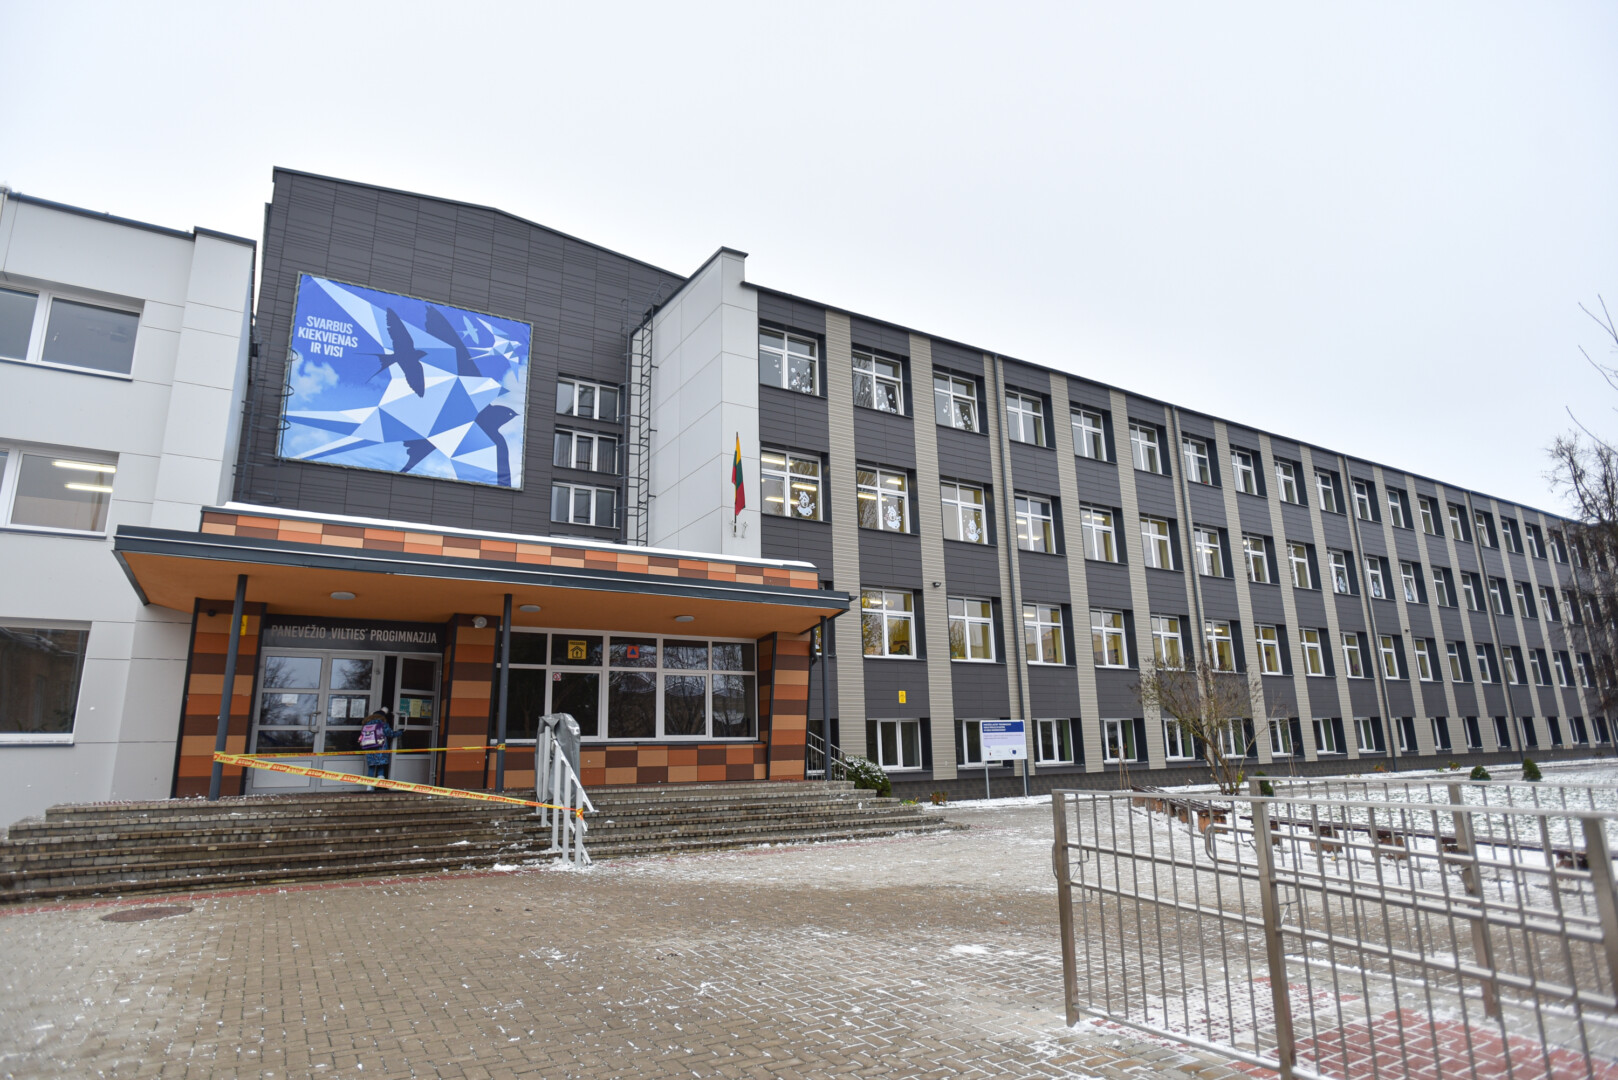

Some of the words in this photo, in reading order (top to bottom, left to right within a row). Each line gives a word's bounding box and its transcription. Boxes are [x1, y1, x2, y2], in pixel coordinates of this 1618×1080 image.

[306, 315, 353, 335] SVARBUS
[298, 326, 358, 348] KIEKVIENAS
[310, 341, 322, 354] IR
[323, 343, 344, 358] VISI
[271, 624, 326, 639] PANEVĖŽIO
[370, 629, 437, 644] PROGIMNAZIJA
